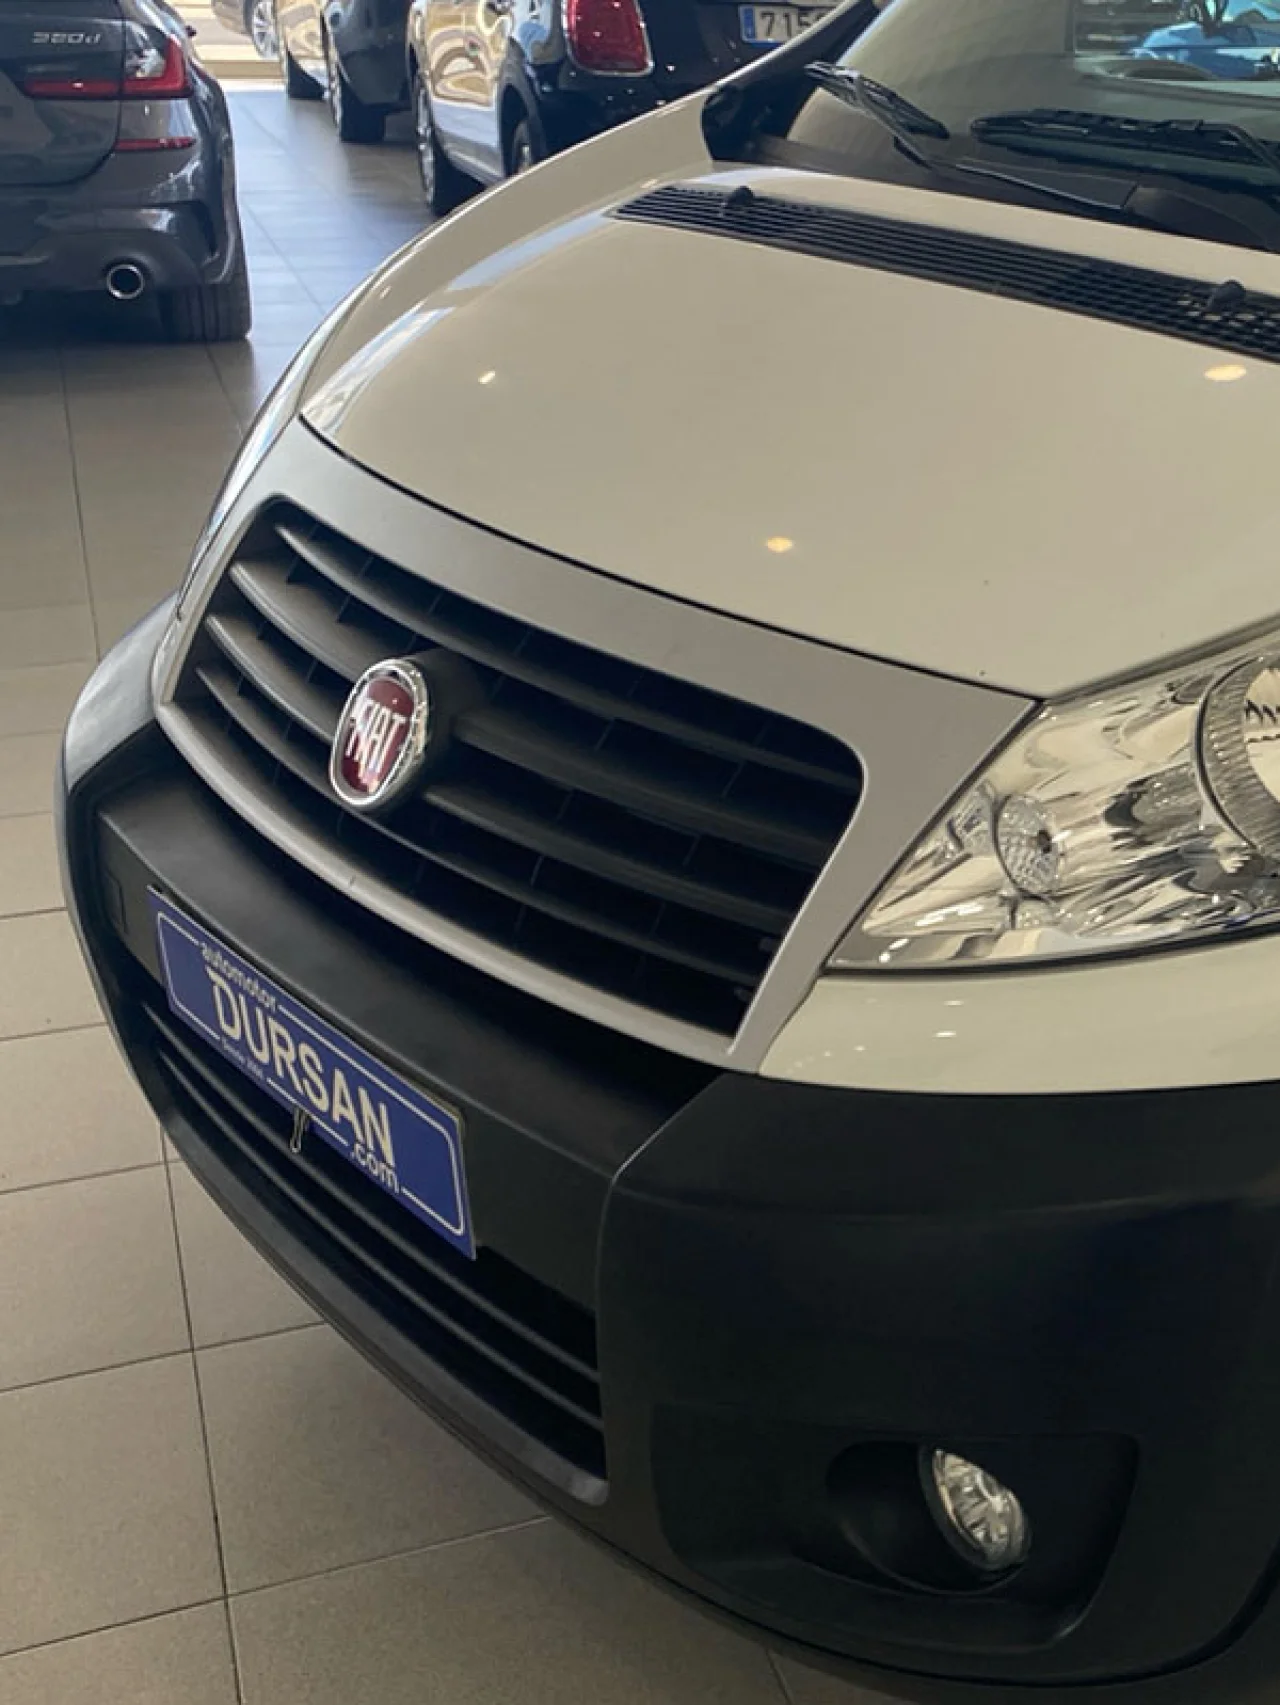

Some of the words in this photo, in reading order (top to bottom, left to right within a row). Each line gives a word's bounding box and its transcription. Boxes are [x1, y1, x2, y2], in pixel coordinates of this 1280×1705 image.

[760, 11, 826, 38] 715
[345, 696, 407, 780] FIAT
[205, 966, 396, 1167] DURSAN
[349, 1141, 399, 1193] .com
